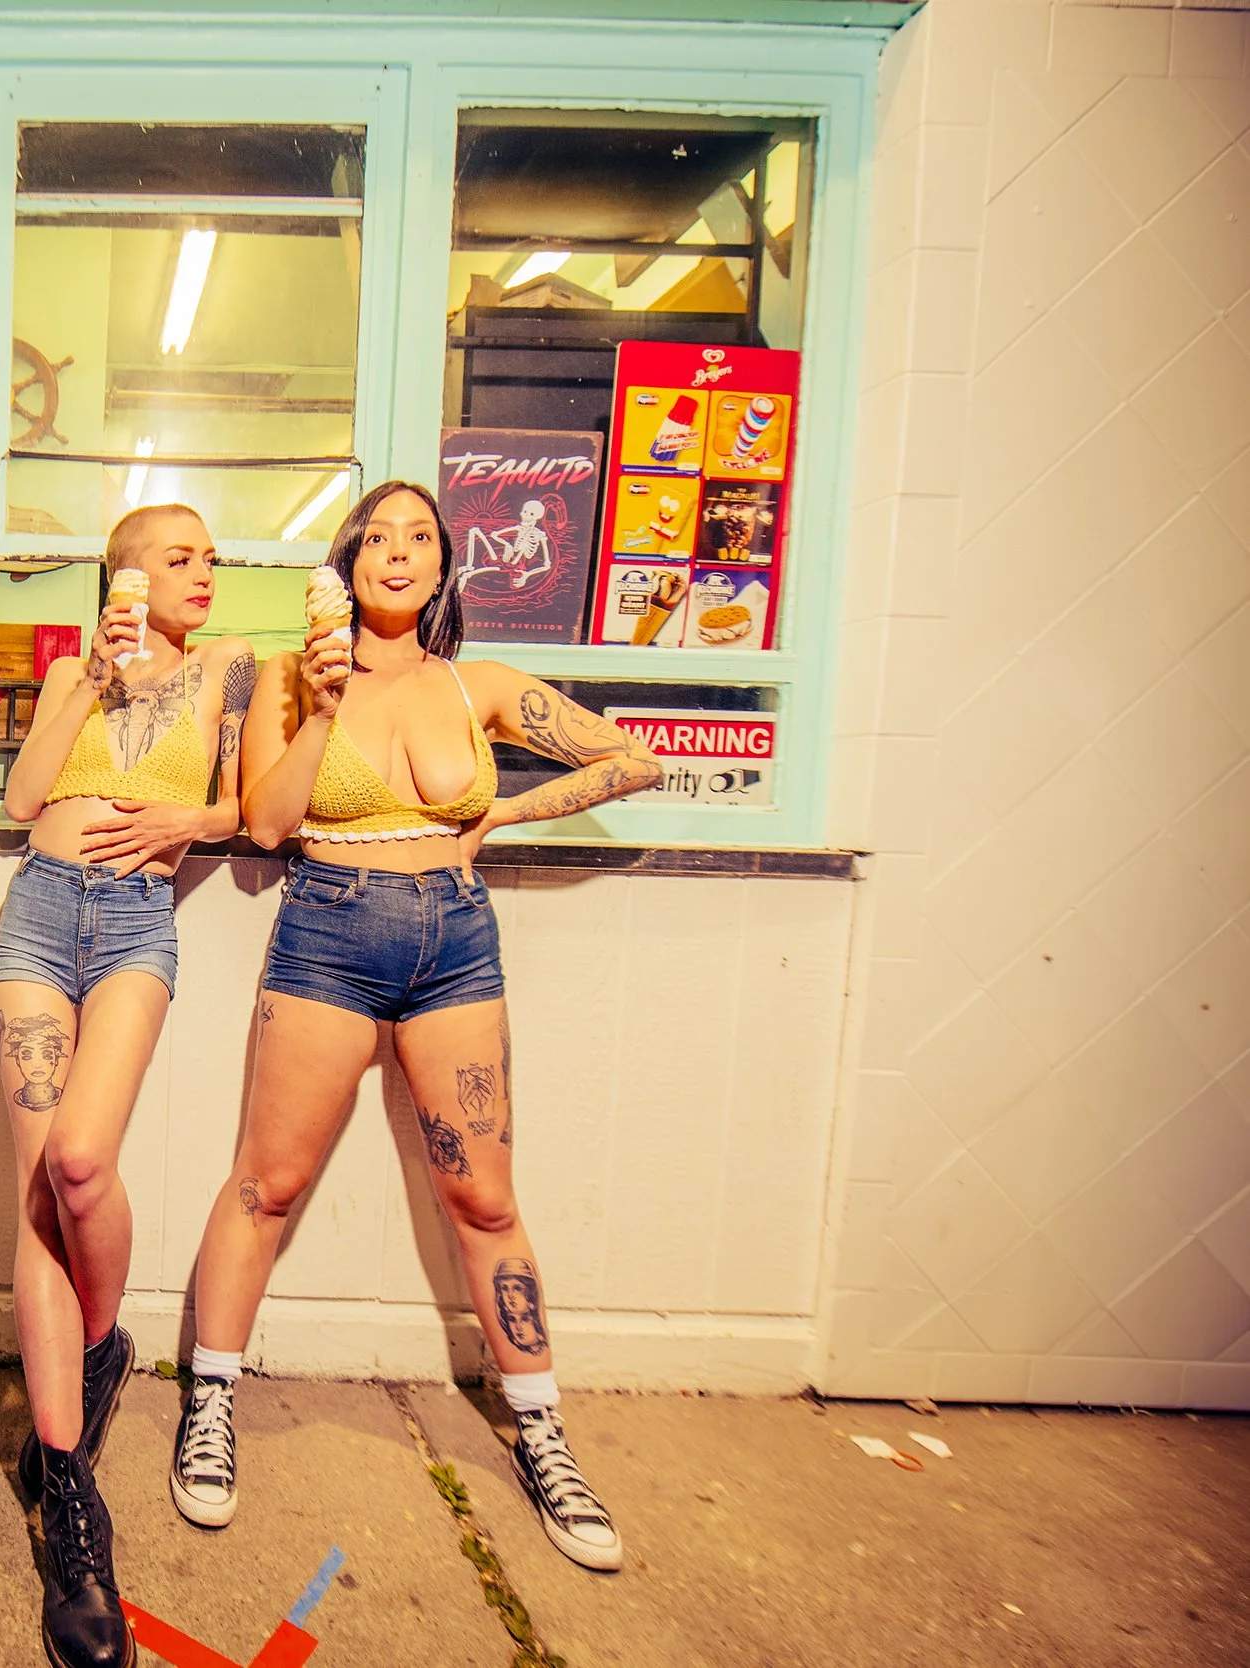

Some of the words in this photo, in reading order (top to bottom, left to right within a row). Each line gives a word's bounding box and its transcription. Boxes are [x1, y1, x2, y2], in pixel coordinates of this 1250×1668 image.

[691, 365, 733, 387] Breyers
[442, 451, 595, 502] TEAMLTD
[510, 622, 564, 631] DIVISION
[623, 723, 771, 755] WARNING
